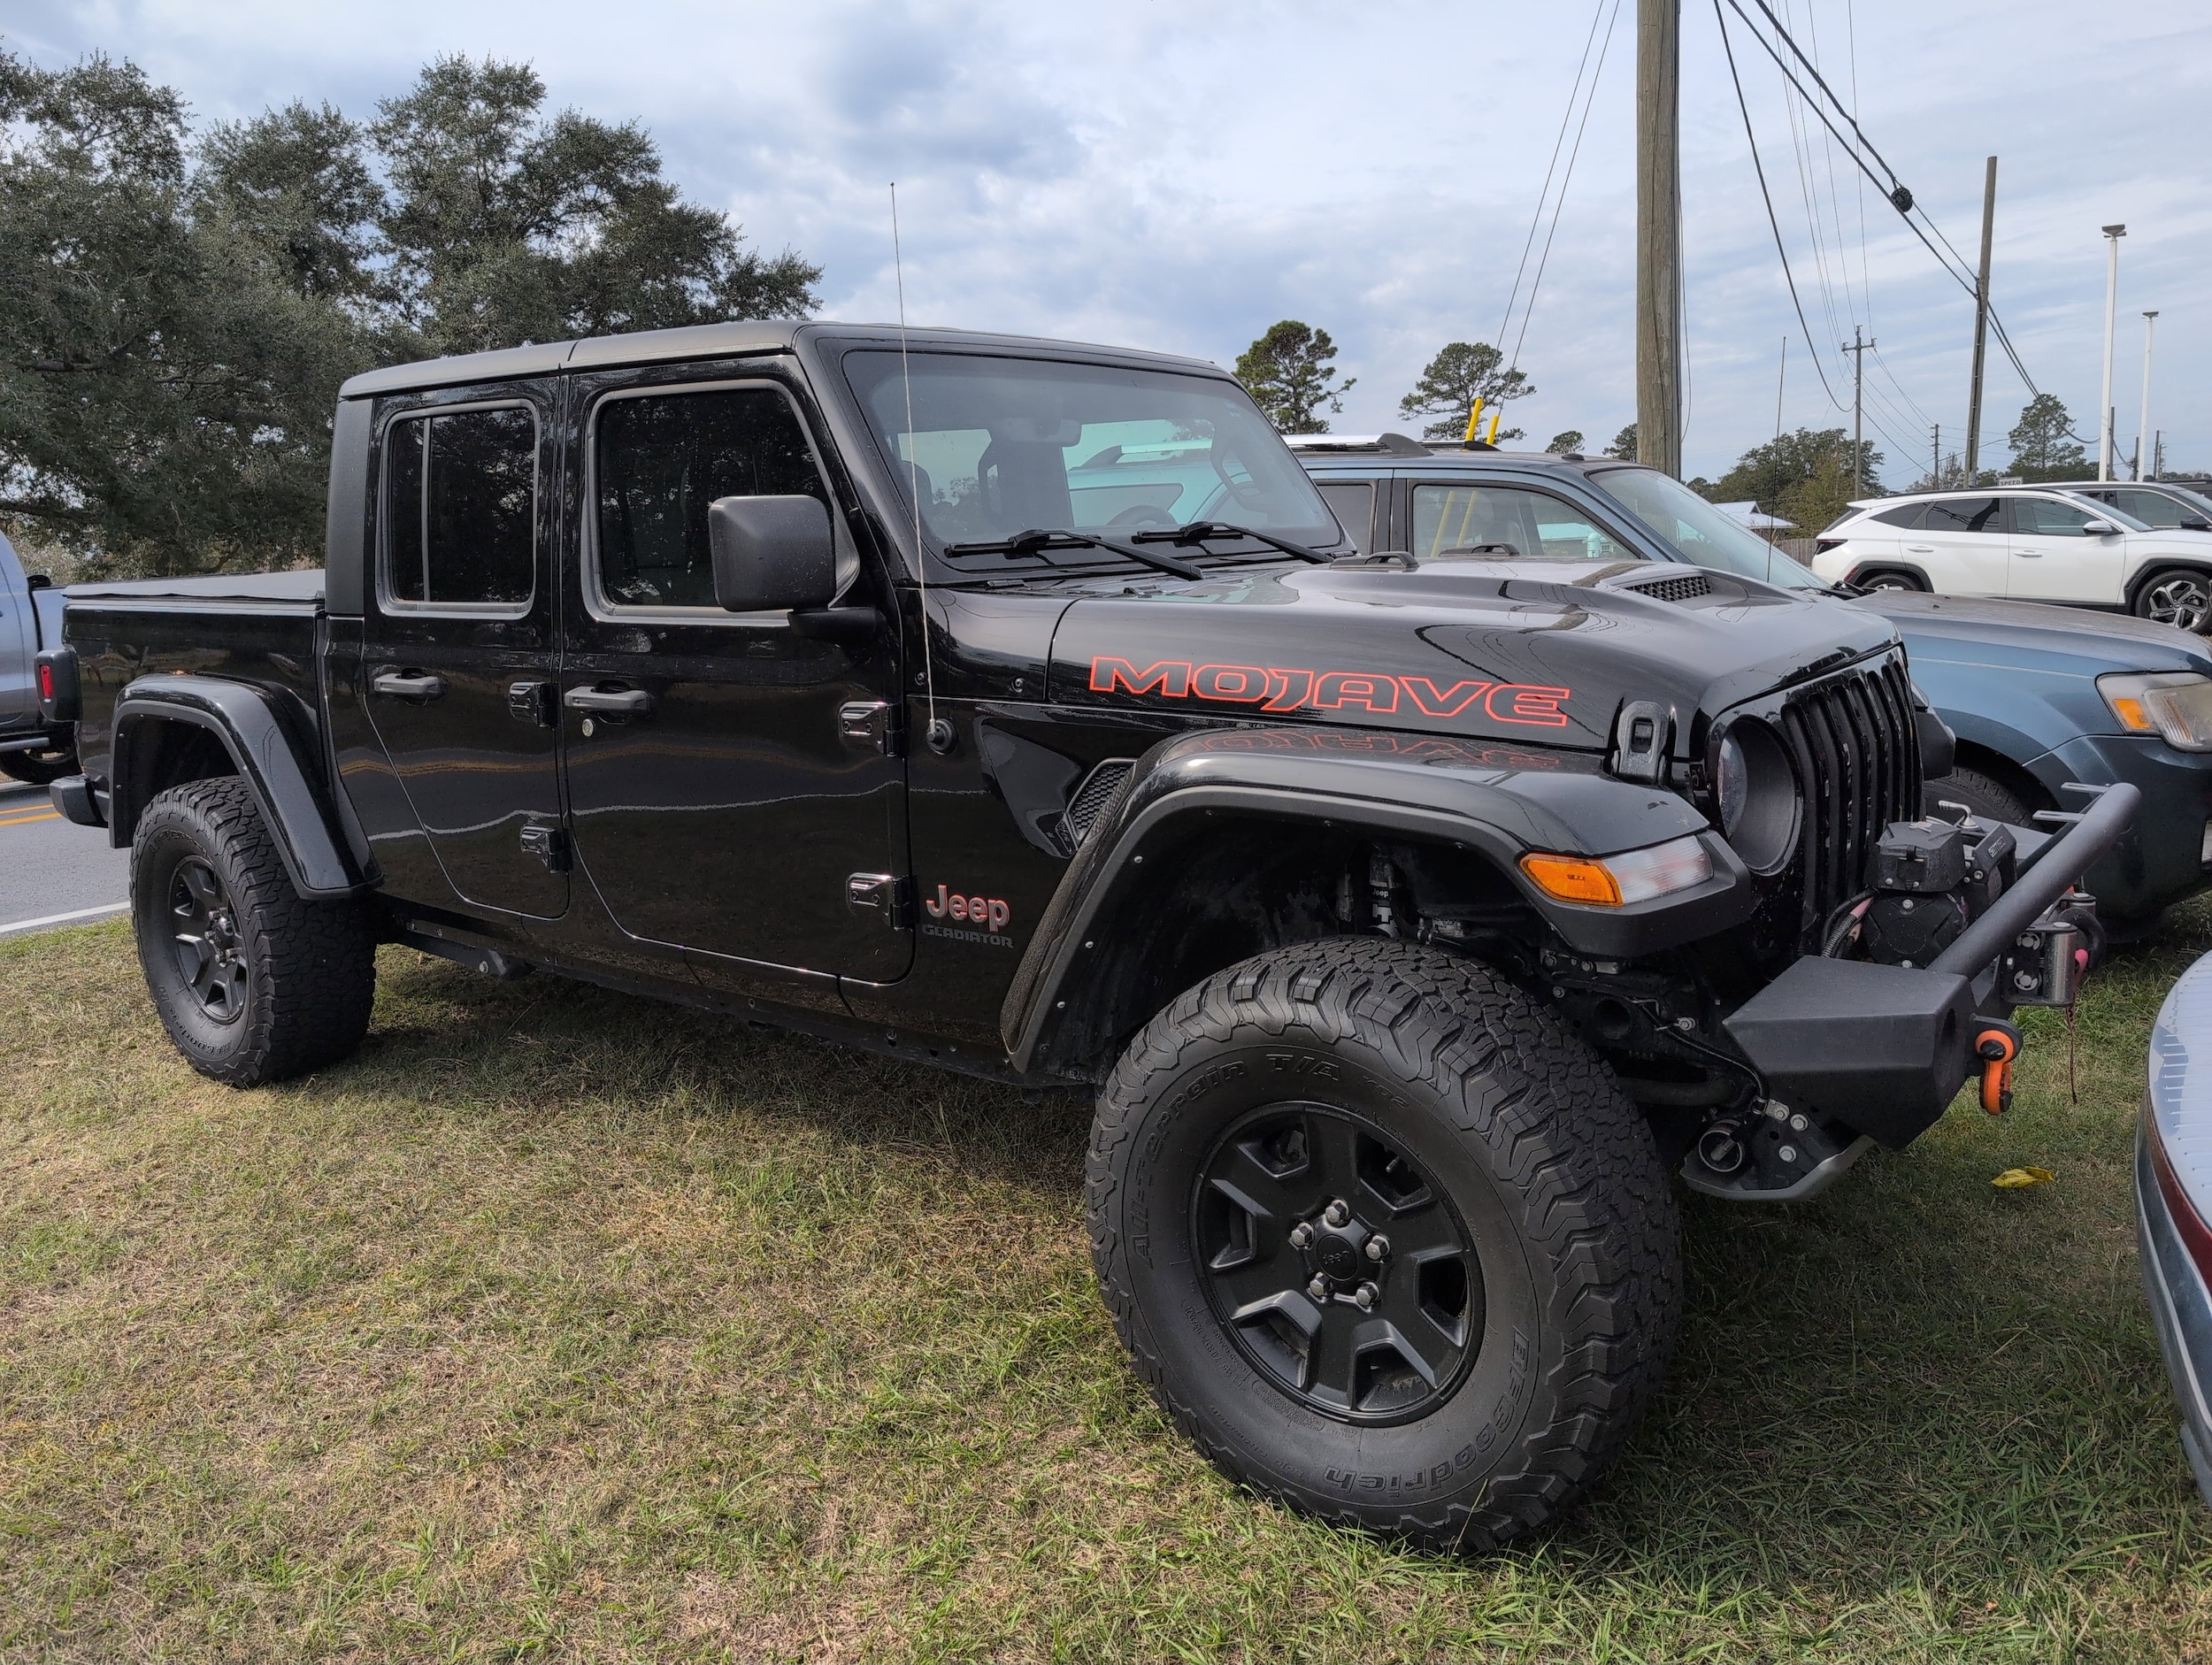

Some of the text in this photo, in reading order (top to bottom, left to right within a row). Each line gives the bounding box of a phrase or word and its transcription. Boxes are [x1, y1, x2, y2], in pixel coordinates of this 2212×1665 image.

[1089, 656, 1571, 727] MOJAVE
[926, 884, 1010, 932] Jeep
[1372, 887, 1389, 898] Jeep
[921, 923, 1014, 948] GLADIATOR
[1266, 1053, 1340, 1082] T/A
[1324, 1324, 1531, 1497] BFGoodrich
